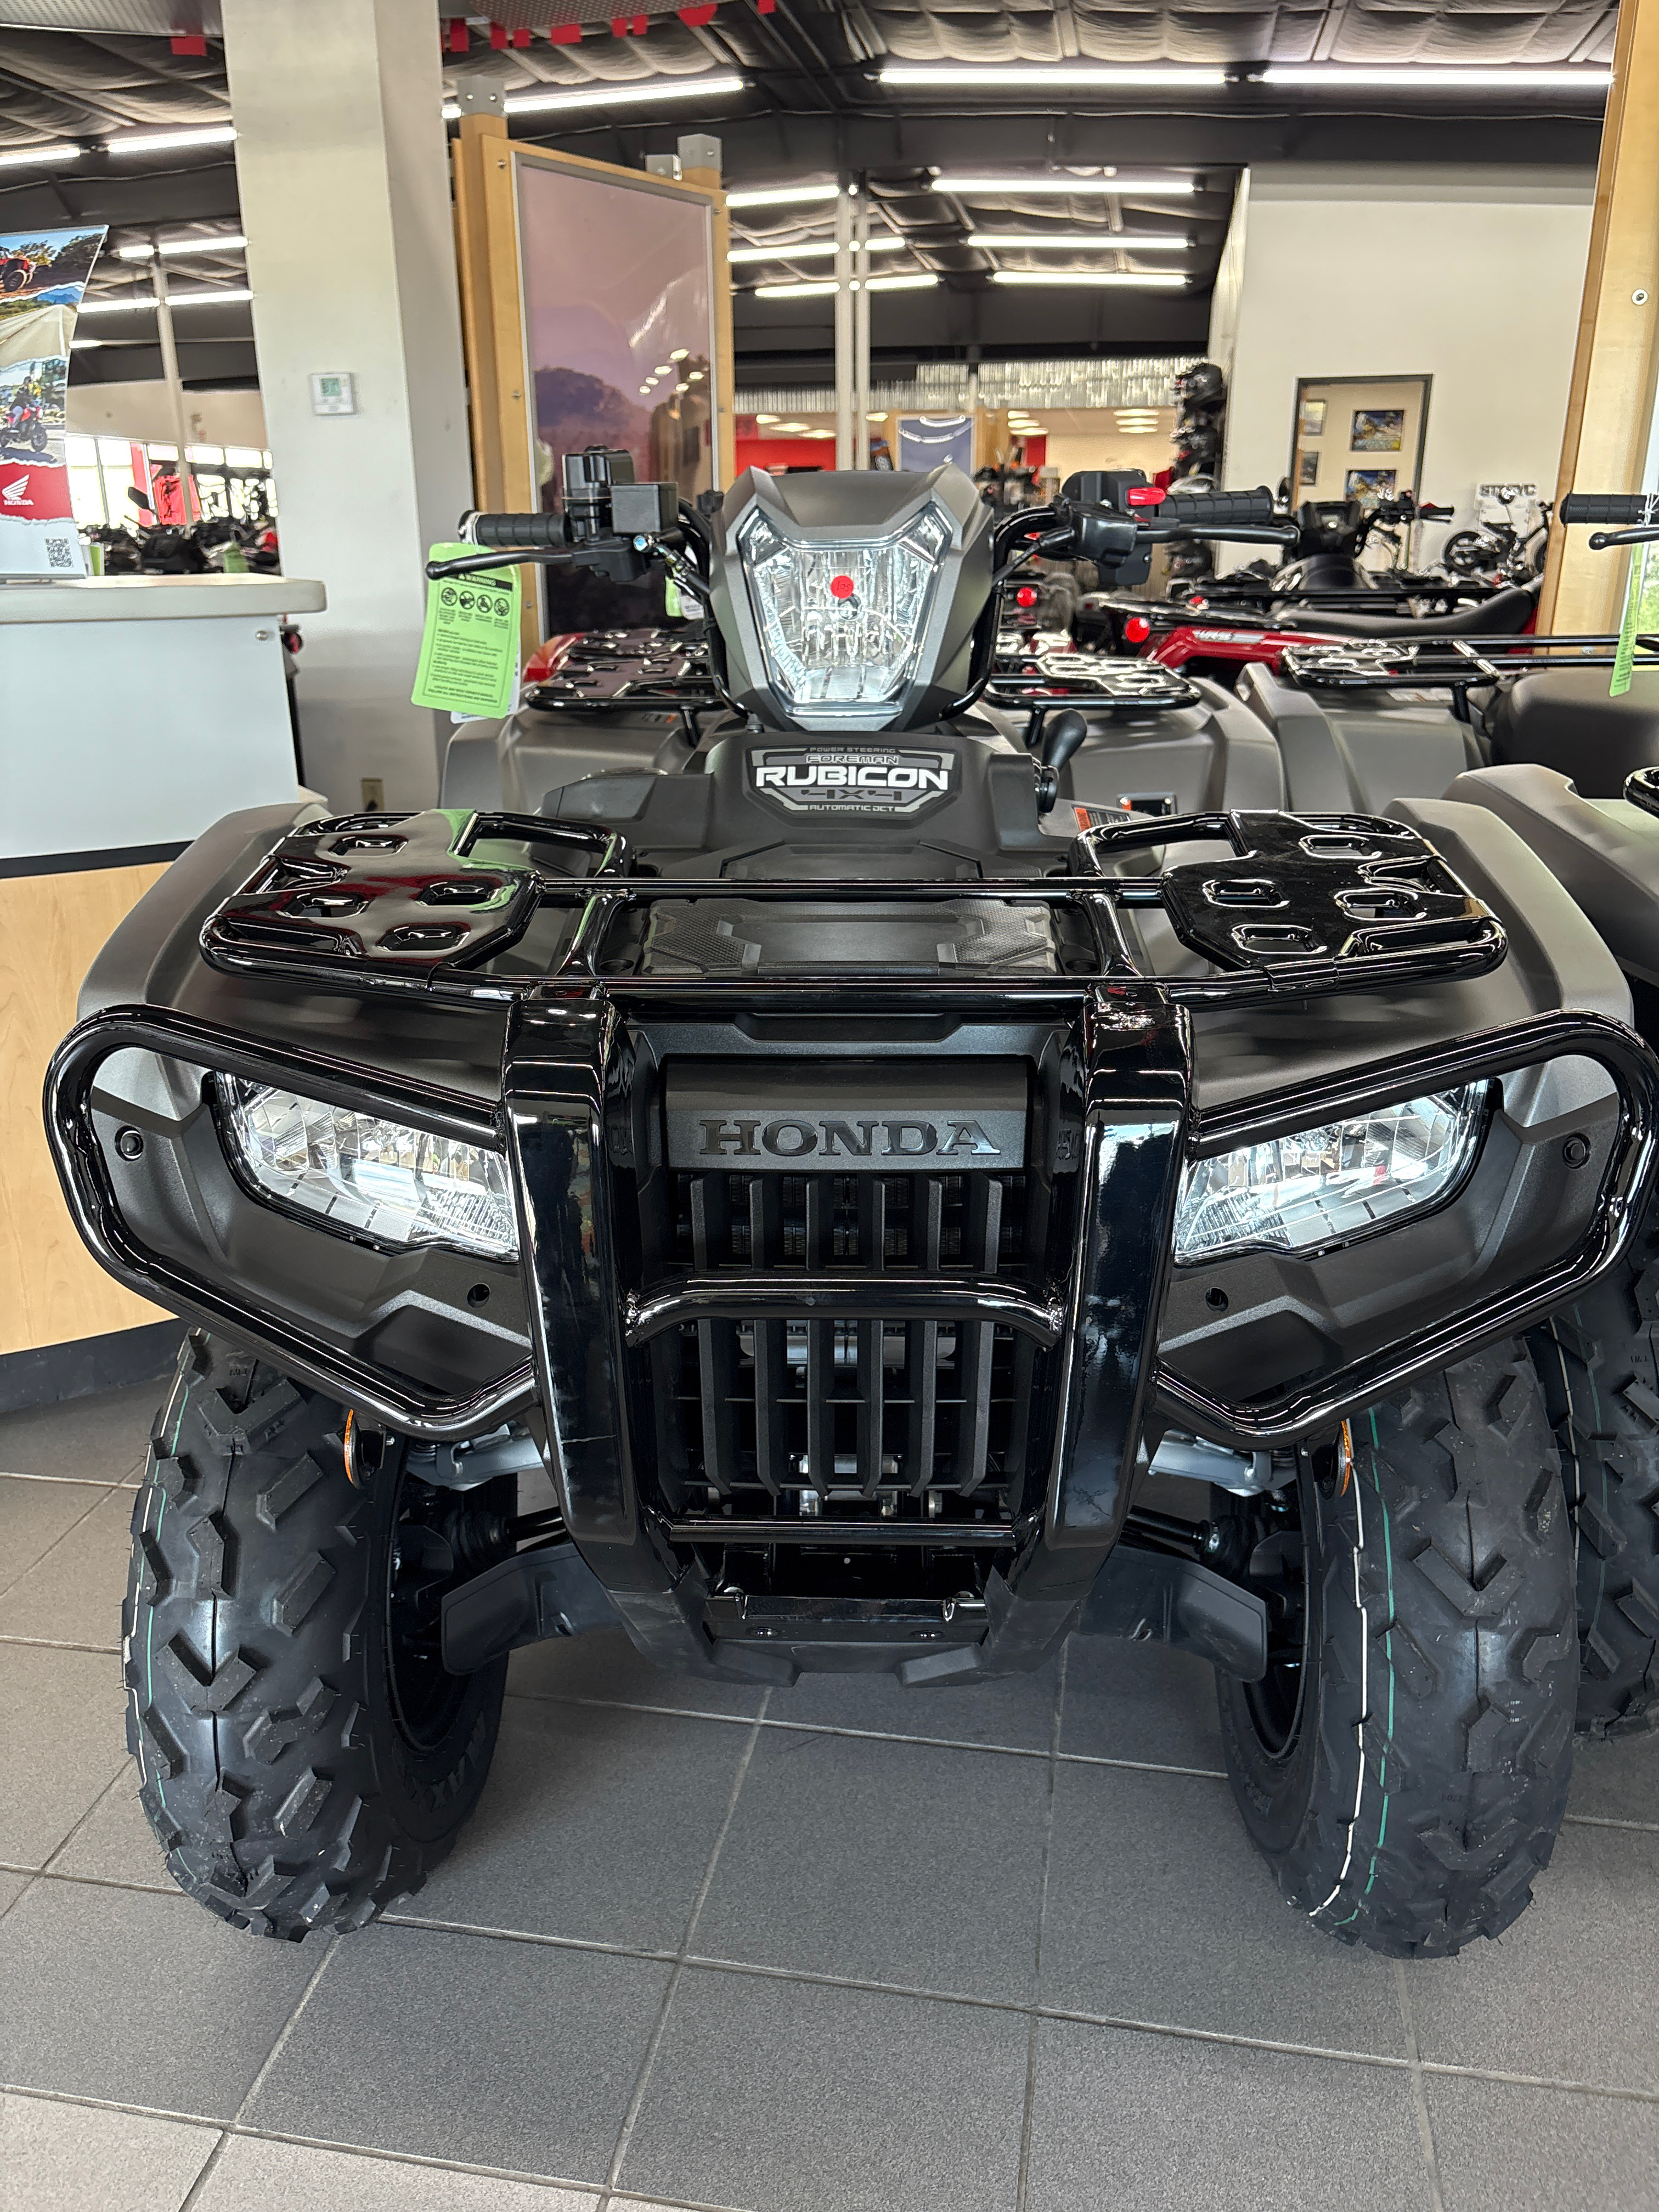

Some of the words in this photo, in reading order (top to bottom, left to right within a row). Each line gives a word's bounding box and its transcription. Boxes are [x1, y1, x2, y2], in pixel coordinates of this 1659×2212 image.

[806, 754, 899, 765] FOREMAN
[755, 766, 949, 791] RUBICON
[699, 1119, 1001, 1156] HONDA
